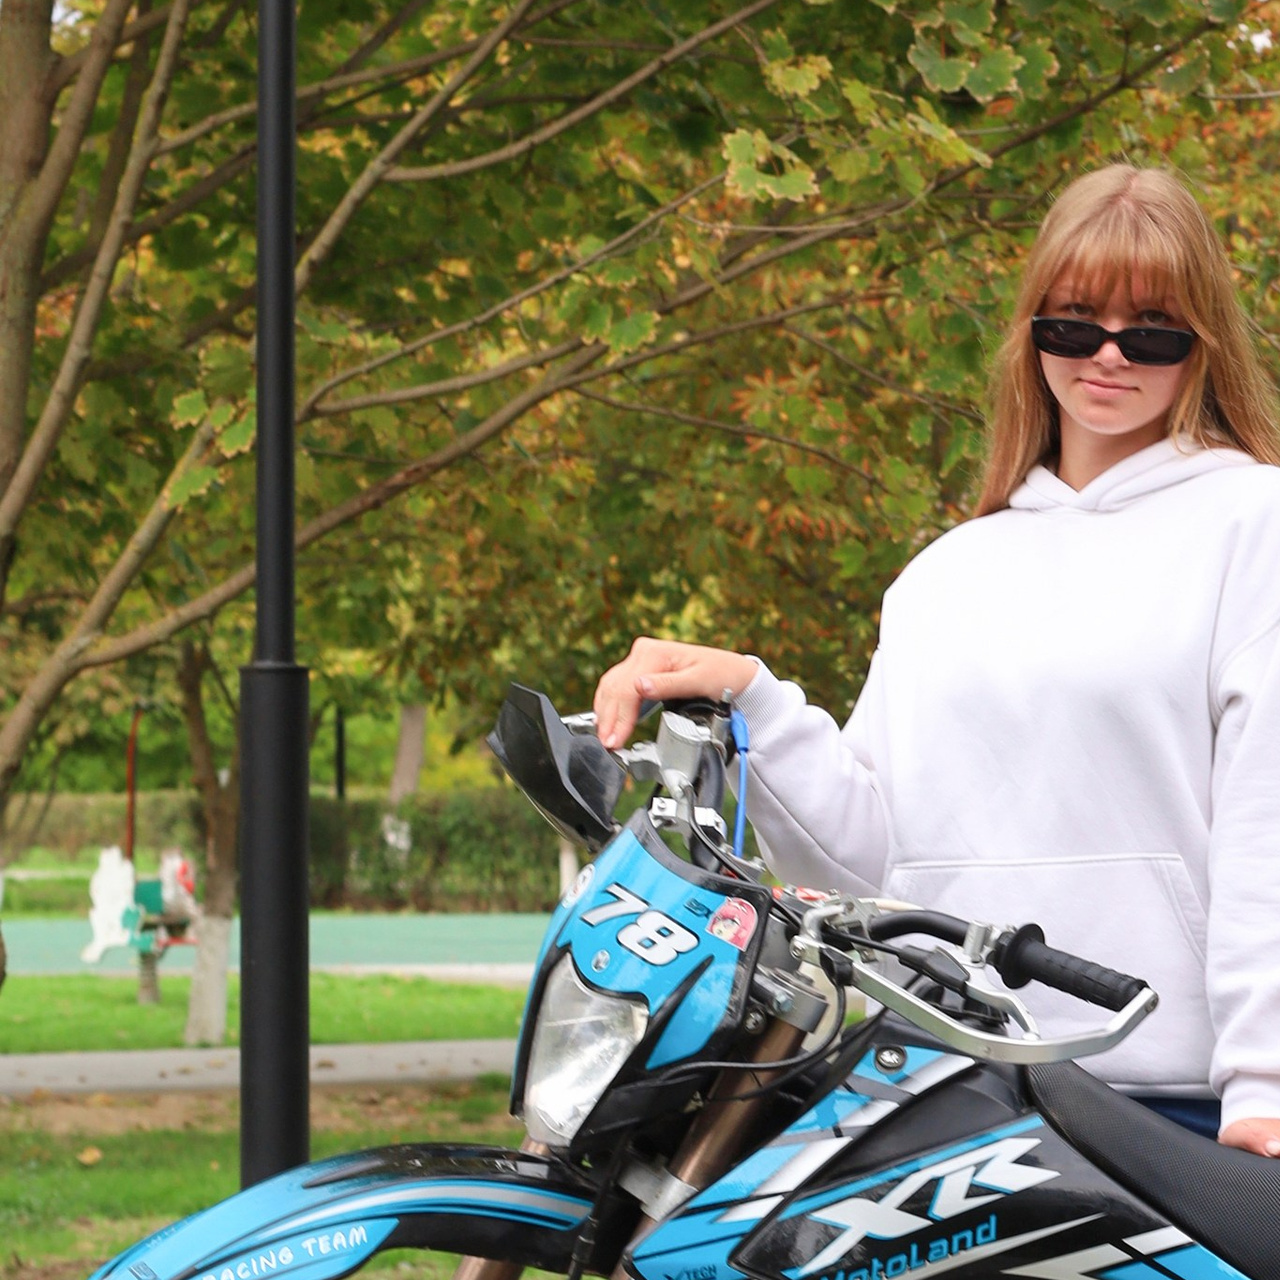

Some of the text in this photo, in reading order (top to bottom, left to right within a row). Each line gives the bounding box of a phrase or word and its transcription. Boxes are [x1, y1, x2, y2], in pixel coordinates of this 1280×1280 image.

[579, 881, 701, 967] 78
[301, 1224, 369, 1258] TEAM
[783, 1137, 1063, 1280] XR
